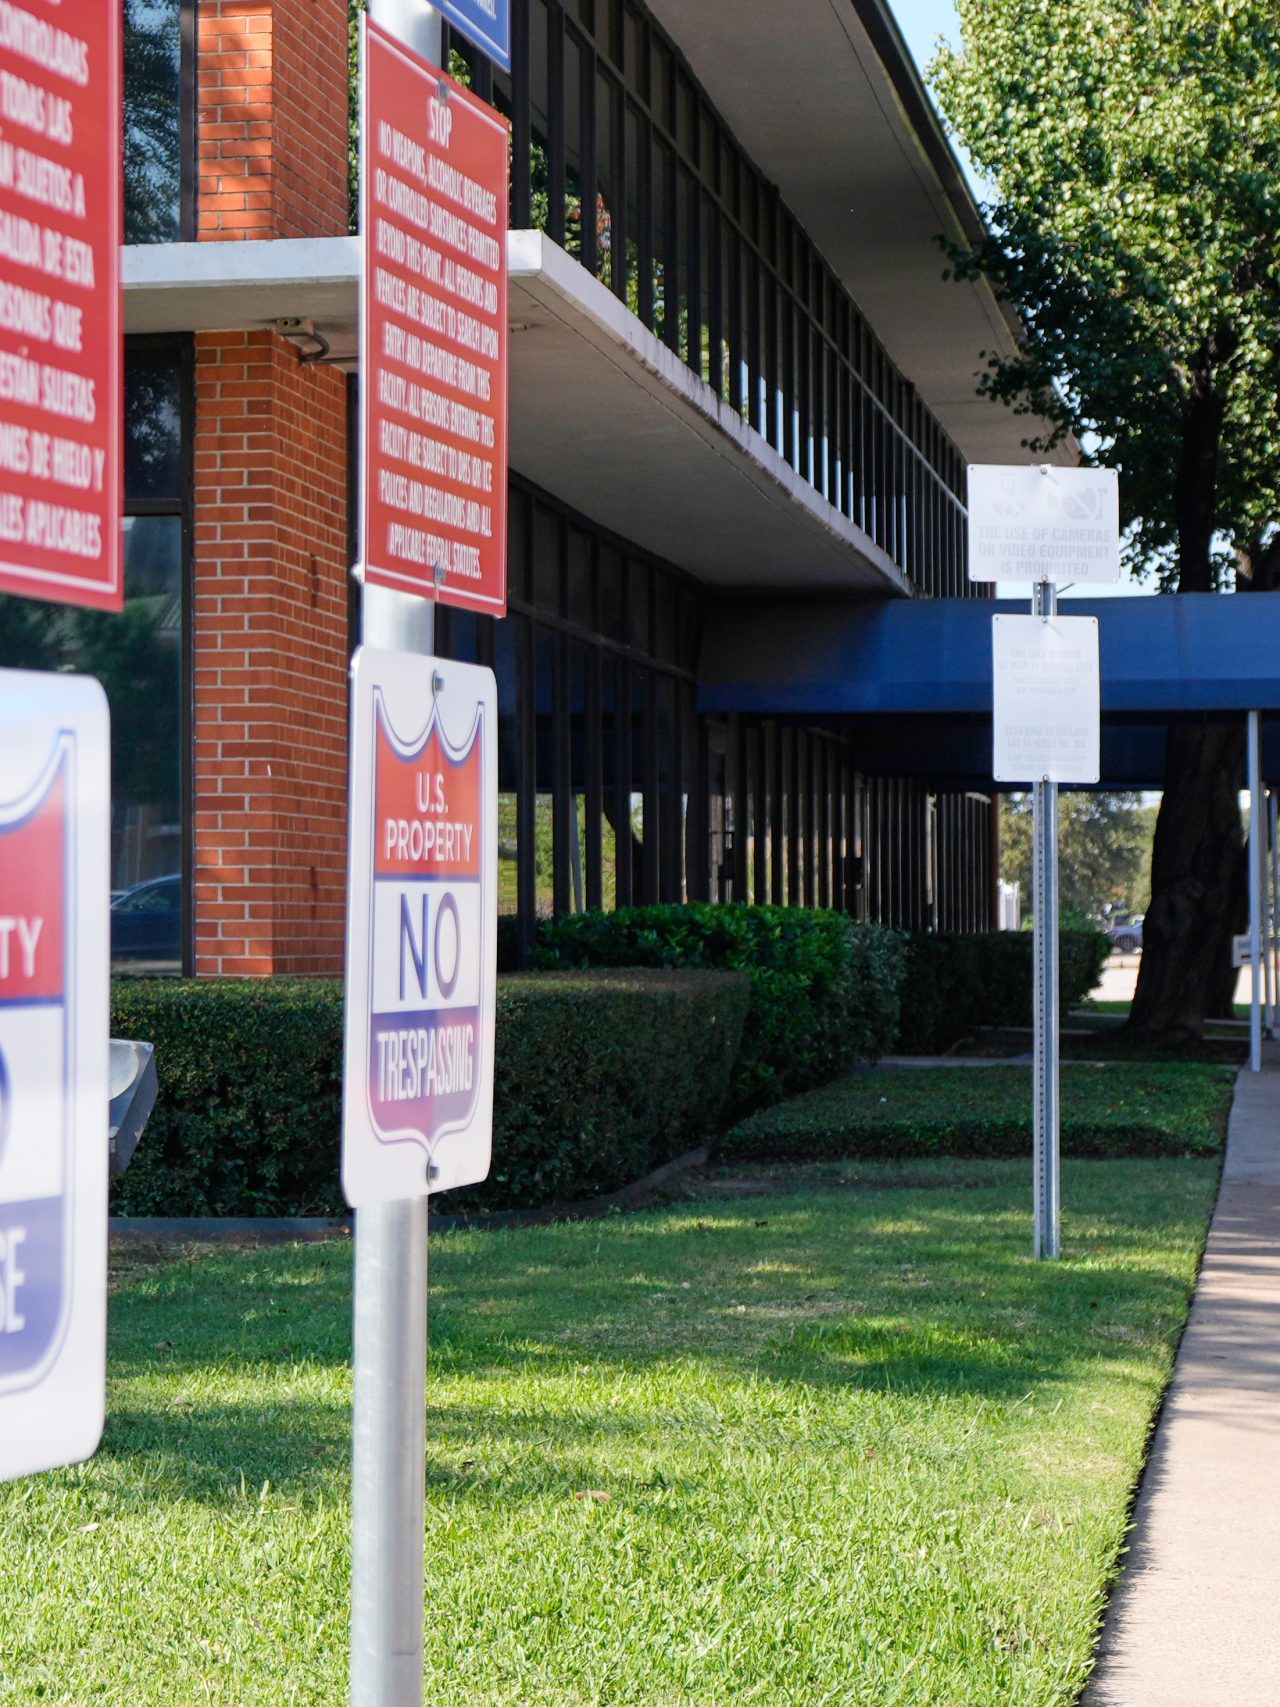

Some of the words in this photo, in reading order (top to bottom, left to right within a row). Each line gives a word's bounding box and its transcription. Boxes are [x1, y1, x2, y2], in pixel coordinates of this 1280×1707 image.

[0, 69, 46, 133] TODAS
[47, 92, 73, 146] LAS
[428, 95, 452, 149] STOP
[15, 146, 73, 211] SUJETOS
[73, 172, 86, 218] A
[380, 118, 391, 156] NO
[393, 127, 426, 186] WEAPONS,
[428, 151, 463, 203] ALCOHOLIC
[464, 176, 496, 225] BEVERAGES
[376, 166, 386, 203] OR
[388, 174, 428, 228] CONTROLLED
[430, 200, 467, 252] SUBSTANCES
[468, 225, 499, 271] PERMITTED
[42, 227, 62, 277] DE
[63, 235, 95, 287] ESTA
[377, 217, 405, 263] BEYOND
[406, 234, 420, 271] THIS
[421, 243, 443, 284] POINT.
[444, 256, 455, 291] ALL
[456, 263, 483, 307] PERSONS
[484, 280, 497, 315] AND
[52, 300, 83, 352] QUE
[376, 266, 405, 312] VEHICLES
[407, 283, 419, 319] ARE
[421, 291, 446, 333] SUBJECT
[447, 305, 455, 338] TO
[457, 310, 480, 350] SEARCH
[481, 323, 498, 360] UPON
[41, 365, 96, 421] SUJETAS
[385, 321, 405, 362] ENTRY
[407, 332, 420, 369] AND
[422, 339, 456, 386] DEPARTURE
[458, 358, 476, 395] FROM
[477, 367, 490, 402] THIS
[379, 368, 407, 410] FACILITY.
[409, 382, 420, 416] ALL
[421, 387, 449, 428] PERSONS
[450, 401, 479, 441] ENTERING
[481, 415, 494, 447] THIS
[30, 430, 50, 478] DE
[52, 437, 92, 487] HIELO
[93, 448, 105, 492] Y
[381, 419, 406, 459] FACILITY
[409, 430, 421, 464] ARE
[422, 436, 446, 474] SUBJECT
[448, 446, 456, 478] TO
[458, 450, 470, 483] DHS
[472, 456, 481, 487] OR
[483, 461, 492, 491] ICE
[25, 499, 102, 558] APLICABLES
[380, 469, 407, 508] POLICIES
[408, 479, 422, 513] AND
[424, 484, 465, 527] REGULATIONS
[467, 500, 479, 532] AND
[481, 505, 492, 536] ALL
[389, 521, 425, 562] APPLICABLE
[426, 533, 451, 569] FEDERAL
[453, 542, 481, 578] STATUTES.
[978, 526, 1001, 540] THE
[1005, 526, 1028, 541] USE
[1033, 527, 1048, 541] OF
[1052, 528, 1111, 544] CAMERAS
[978, 543, 995, 557] OR
[999, 543, 1036, 558] VIDEO
[1040, 545, 1111, 560] EQUIPMENT
[1001, 560, 1012, 574] IS
[1016, 560, 1090, 577] PROHIBITED
[415, 772, 449, 814] U.S.
[385, 820, 473, 862] PROPERTY
[399, 891, 461, 1001] NO
[377, 1024, 473, 1102] TRESPASSING
